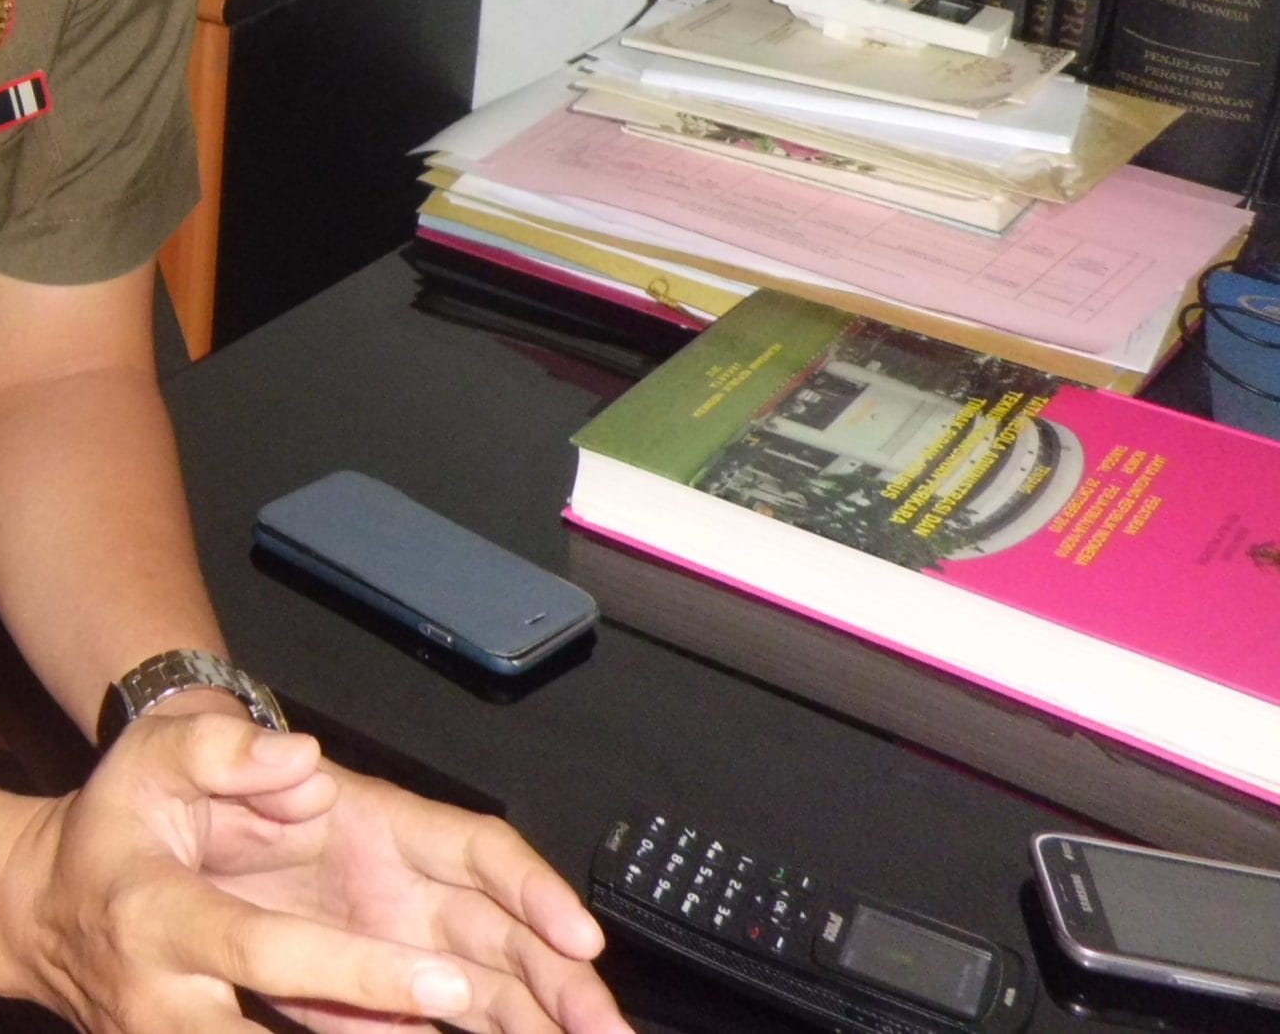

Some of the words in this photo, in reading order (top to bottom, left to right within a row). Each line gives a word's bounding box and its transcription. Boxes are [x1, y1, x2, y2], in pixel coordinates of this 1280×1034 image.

[1143, 48, 1231, 77] PENJELASAN
[1143, 64, 1225, 91] PERATURAN
[985, 390, 1024, 423] TEKNIS
[1021, 395, 1050, 418] TATA
[950, 396, 987, 431] TINDAK
[931, 450, 1000, 516] ADMINISTRASI
[912, 512, 943, 538] DAN
[684, 827, 696, 840] 7
[641, 838, 654, 850] 0
[711, 839, 724, 853] 4
[671, 853, 684, 866] 8
[741, 855, 753, 865] 1
[700, 865, 713, 878] 5
[658, 878, 671, 890] 9
[730, 878, 742, 891] 2
[687, 892, 700, 905] 6
[718, 904, 731, 917] 3
